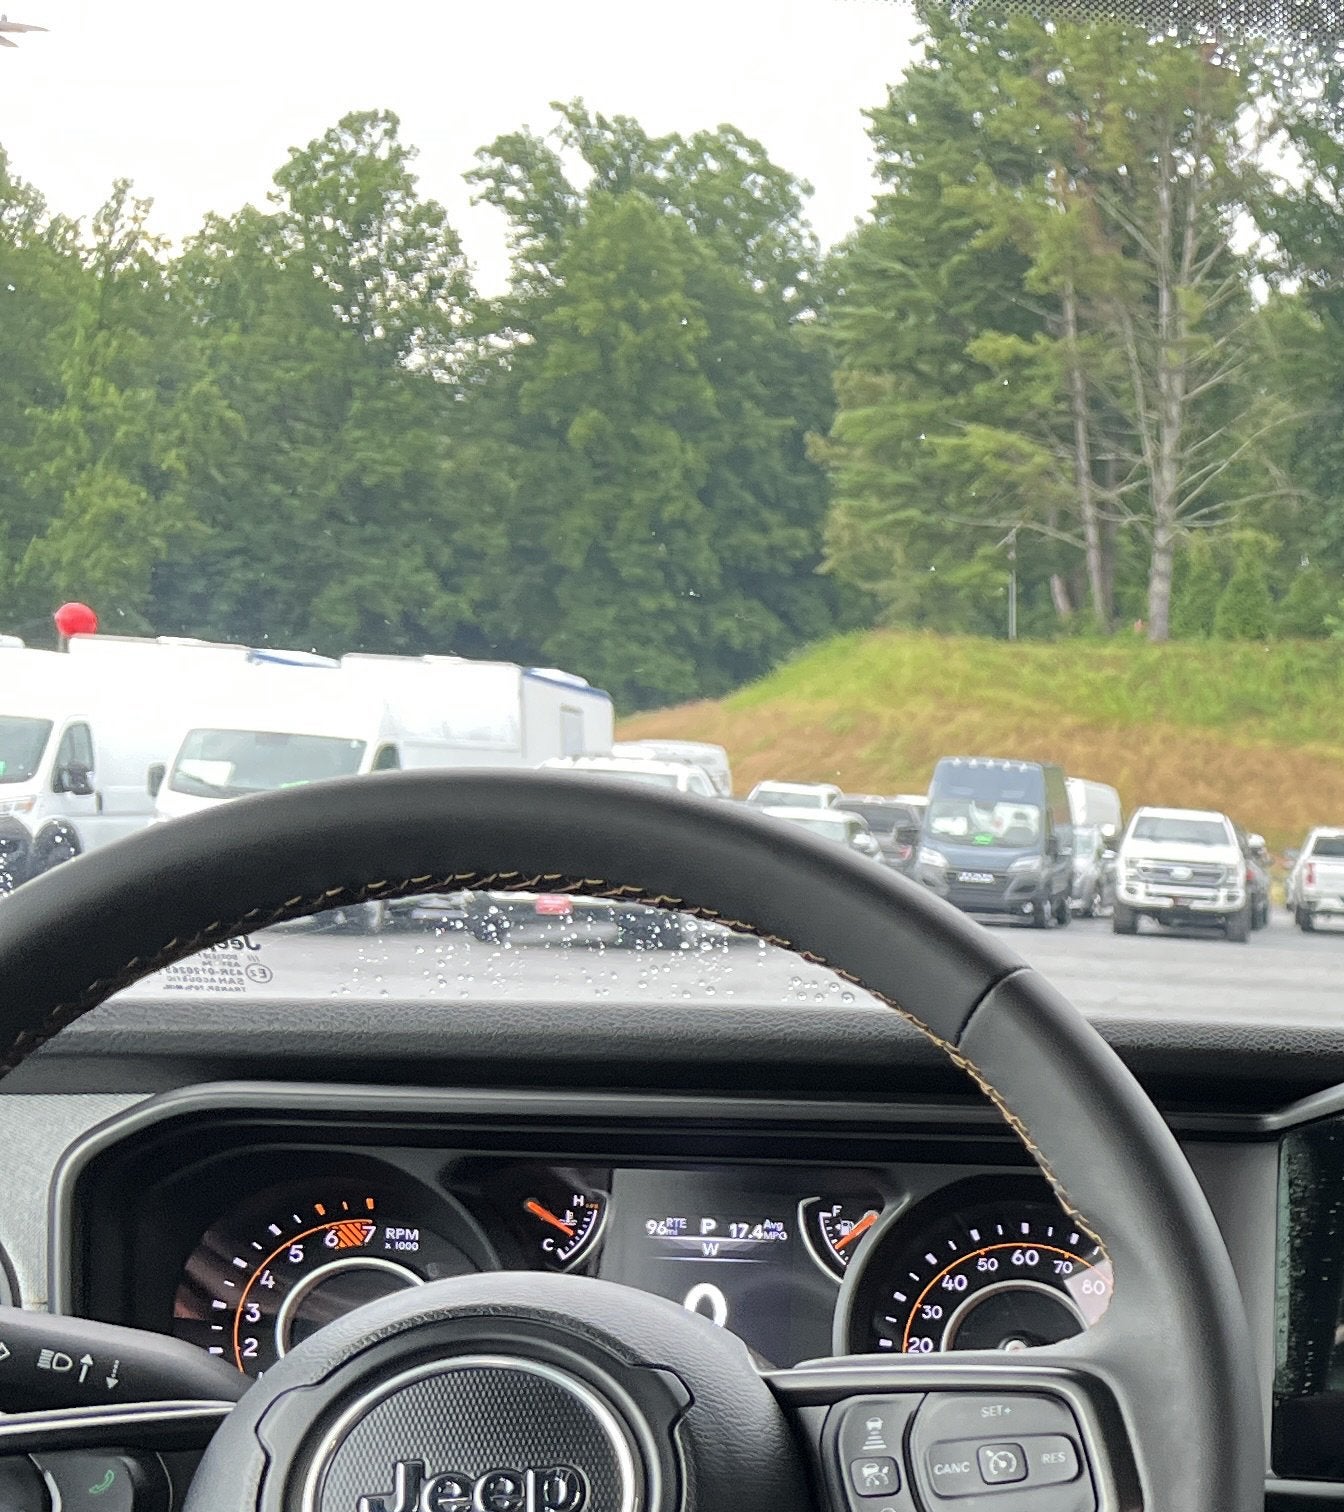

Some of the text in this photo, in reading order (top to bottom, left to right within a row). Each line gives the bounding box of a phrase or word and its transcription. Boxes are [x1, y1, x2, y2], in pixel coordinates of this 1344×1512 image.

[572, 1194, 585, 1207] H
[831, 1205, 843, 1218] F
[645, 1218, 668, 1236] 96
[666, 1217, 688, 1229] RTE
[700, 1217, 717, 1235] P
[763, 1218, 784, 1233] Avg
[324, 1229, 340, 1248] 6
[361, 1225, 378, 1244] 7
[384, 1227, 420, 1242] RPM
[728, 1222, 764, 1241] 17.4
[762, 1230, 789, 1242] MPG
[394, 1241, 420, 1251] 1000
[542, 1237, 555, 1252] C
[701, 1242, 720, 1257] W
[288, 1244, 305, 1264] 5
[1010, 1249, 1040, 1266] 60
[976, 1257, 1000, 1272] 50
[1053, 1259, 1074, 1275] 70
[260, 1269, 276, 1289] 4
[940, 1273, 969, 1292] 40
[1081, 1279, 1106, 1296] 80
[245, 1303, 262, 1323] 3
[921, 1304, 943, 1320] 30
[242, 1337, 260, 1358] 2
[907, 1336, 934, 1354] 20
[1040, 1451, 1067, 1465] RES
[933, 1461, 971, 1476] CANC
